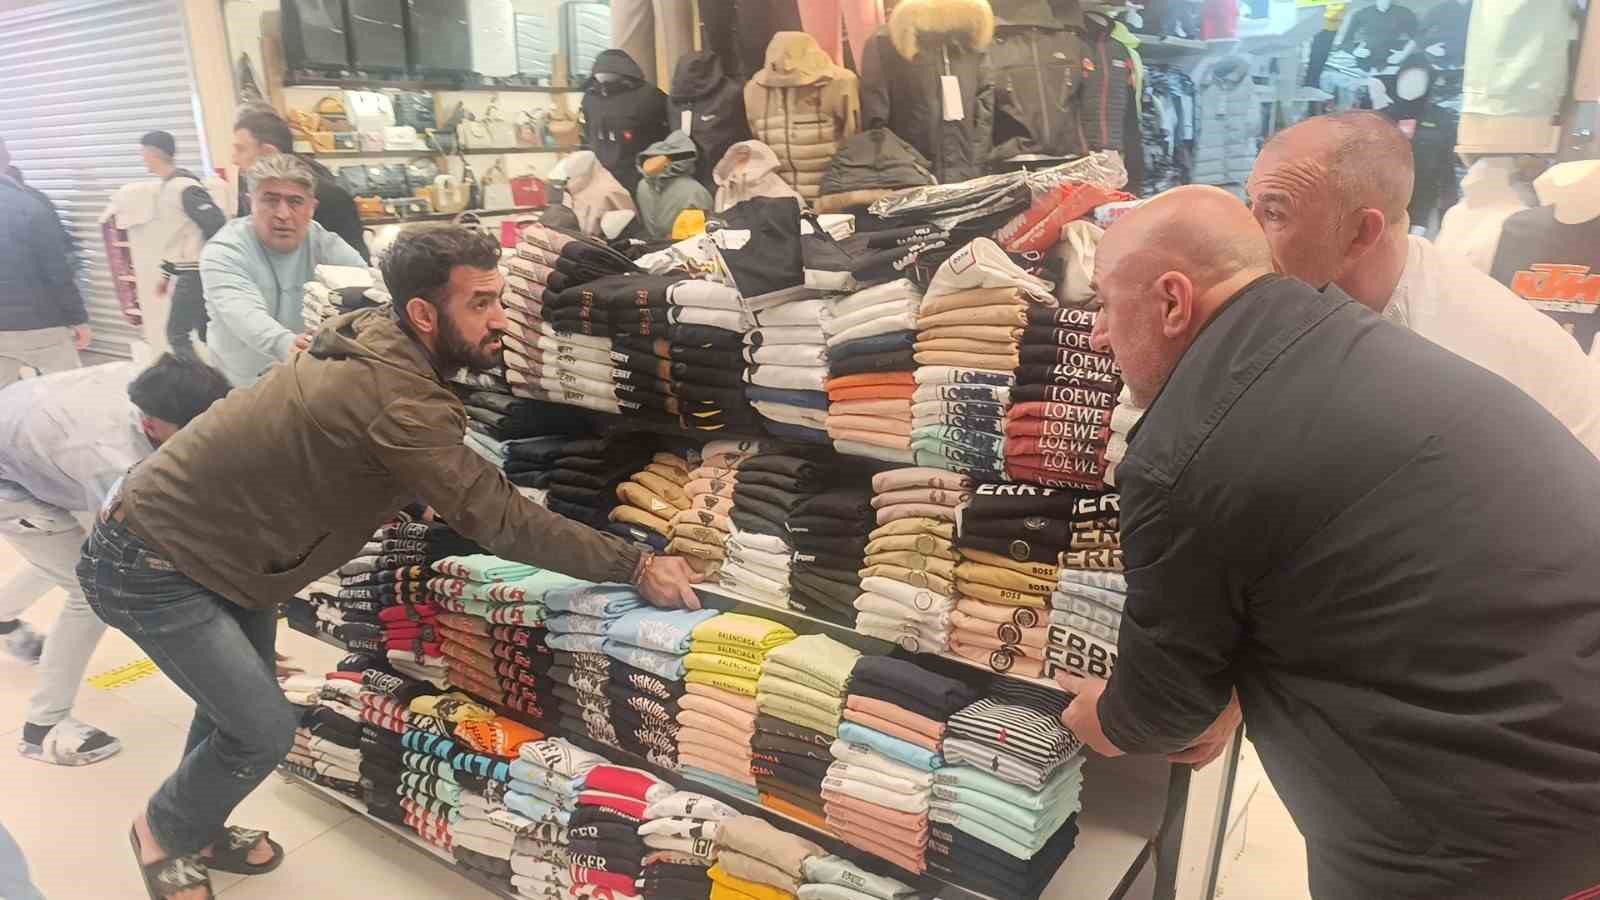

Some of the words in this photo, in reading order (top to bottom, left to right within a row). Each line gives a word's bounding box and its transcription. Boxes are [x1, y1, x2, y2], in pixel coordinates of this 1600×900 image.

[1511, 270, 1600, 304] KTM
[1062, 350, 1122, 376] LOEWE
[1051, 386, 1112, 408] LOEWE
[1044, 402, 1104, 425] LOEWE
[1042, 420, 1100, 440] LOEWE
[1038, 437, 1095, 455] LOEWE
[1044, 452, 1099, 475] LOEWE
